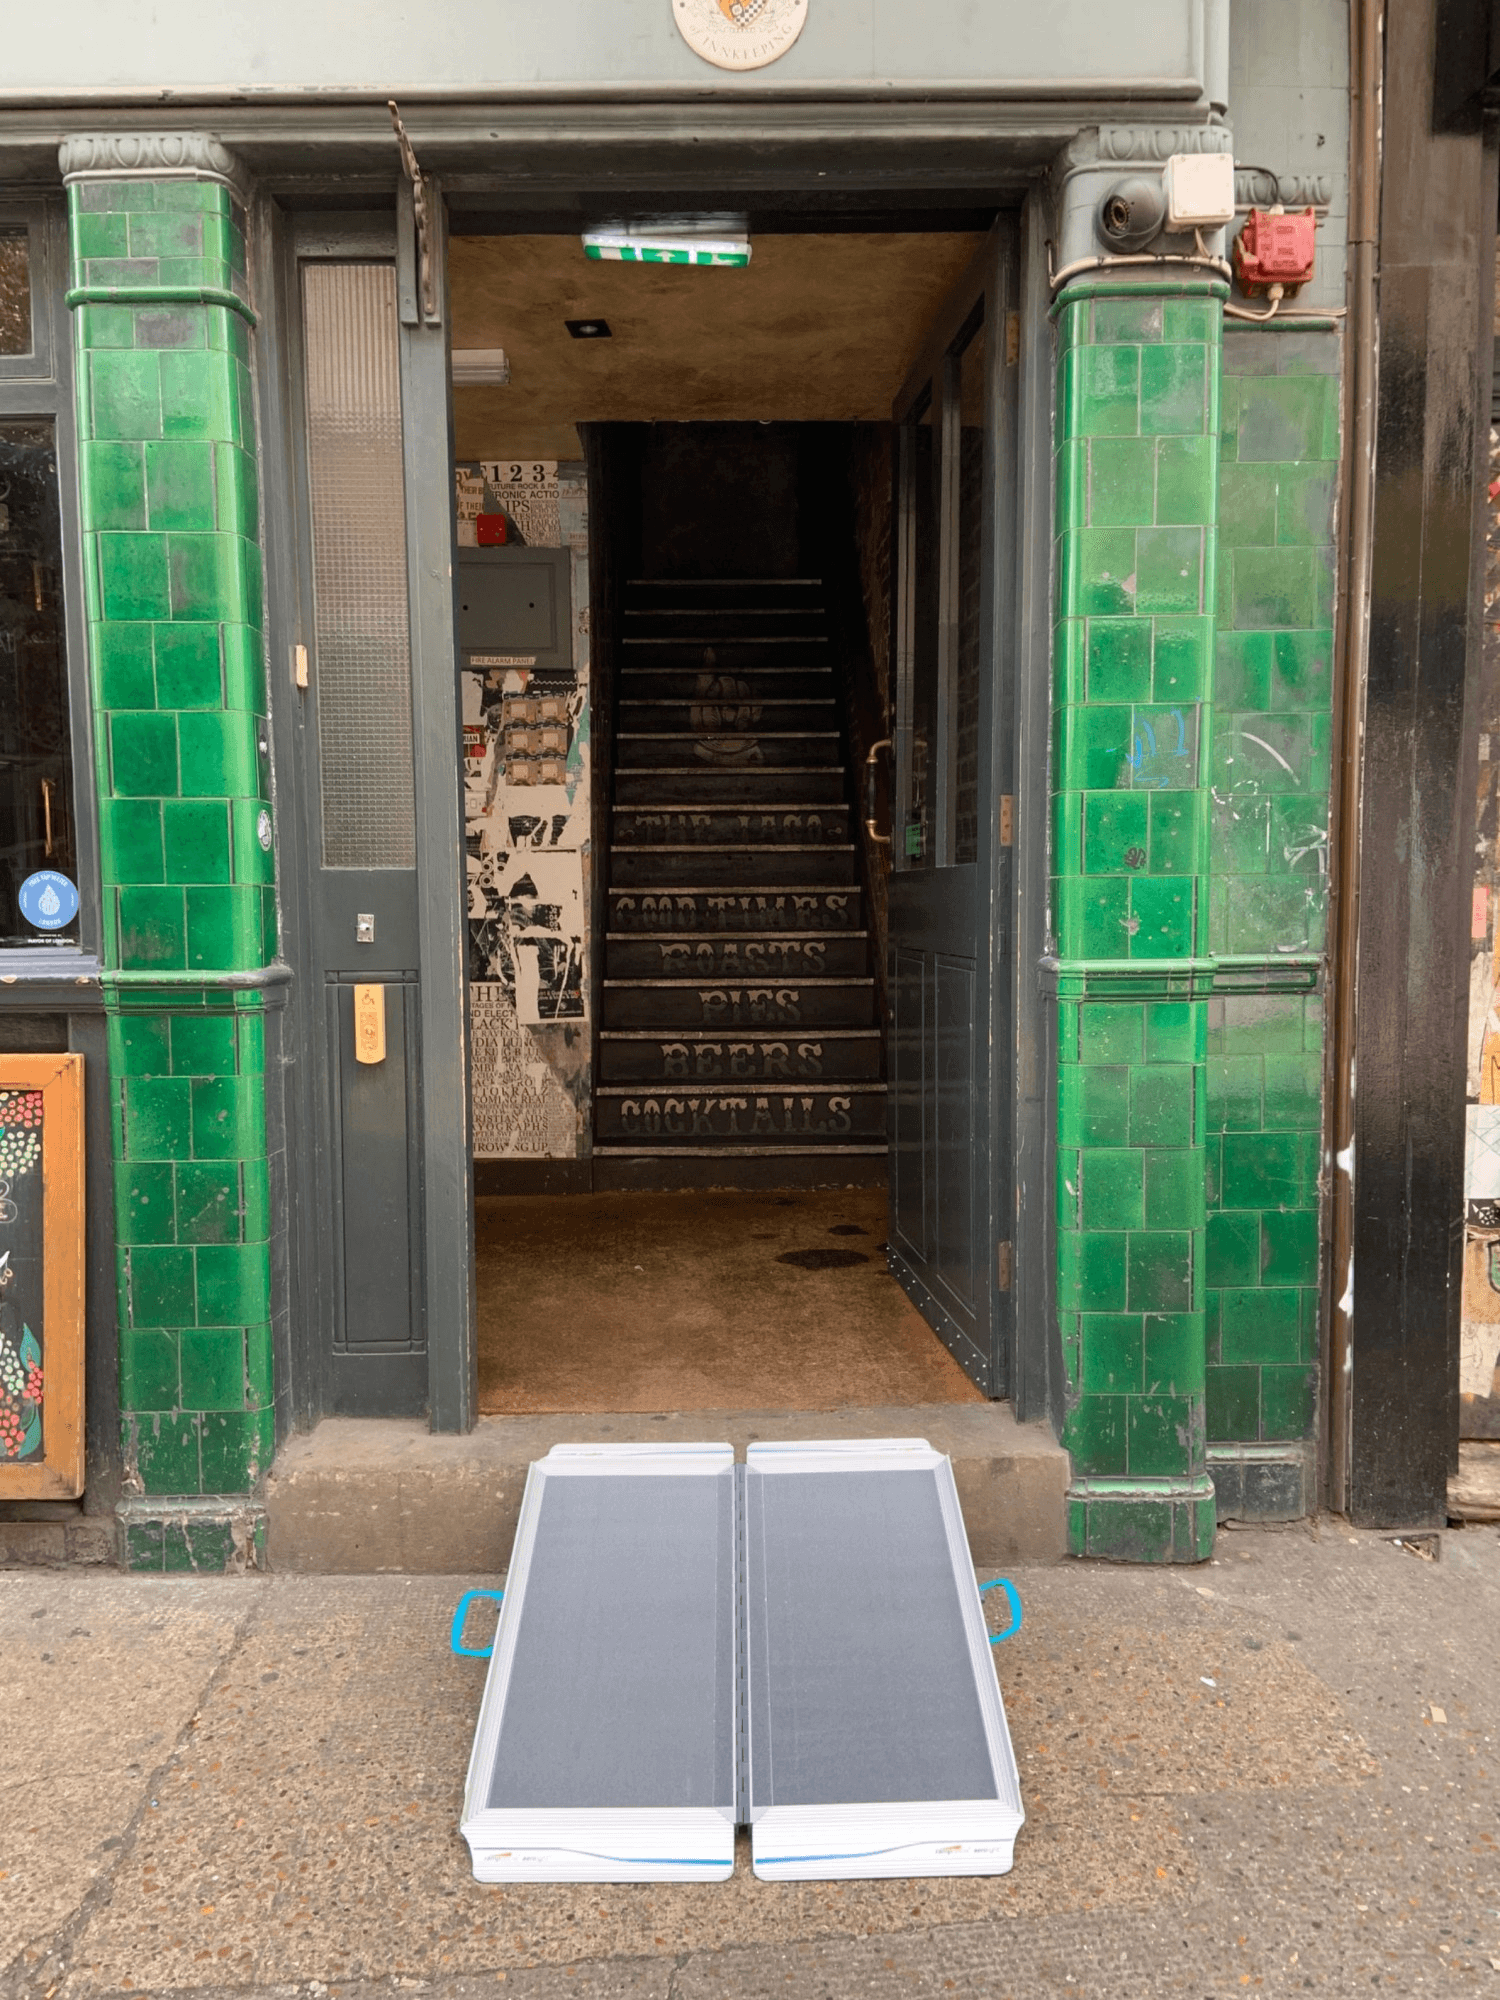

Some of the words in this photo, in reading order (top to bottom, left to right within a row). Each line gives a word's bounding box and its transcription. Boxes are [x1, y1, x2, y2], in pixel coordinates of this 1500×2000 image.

[702, 24, 793, 60] INNKEEPING
[506, 500, 530, 512] IPS
[530, 490, 560, 498] ACTIO
[658, 940, 828, 975] ROASTS
[698, 989, 801, 1022] PIES
[660, 1042, 823, 1076] BEERS
[620, 1096, 853, 1135] COCKTAILS
[532, 1143, 548, 1152] UP
